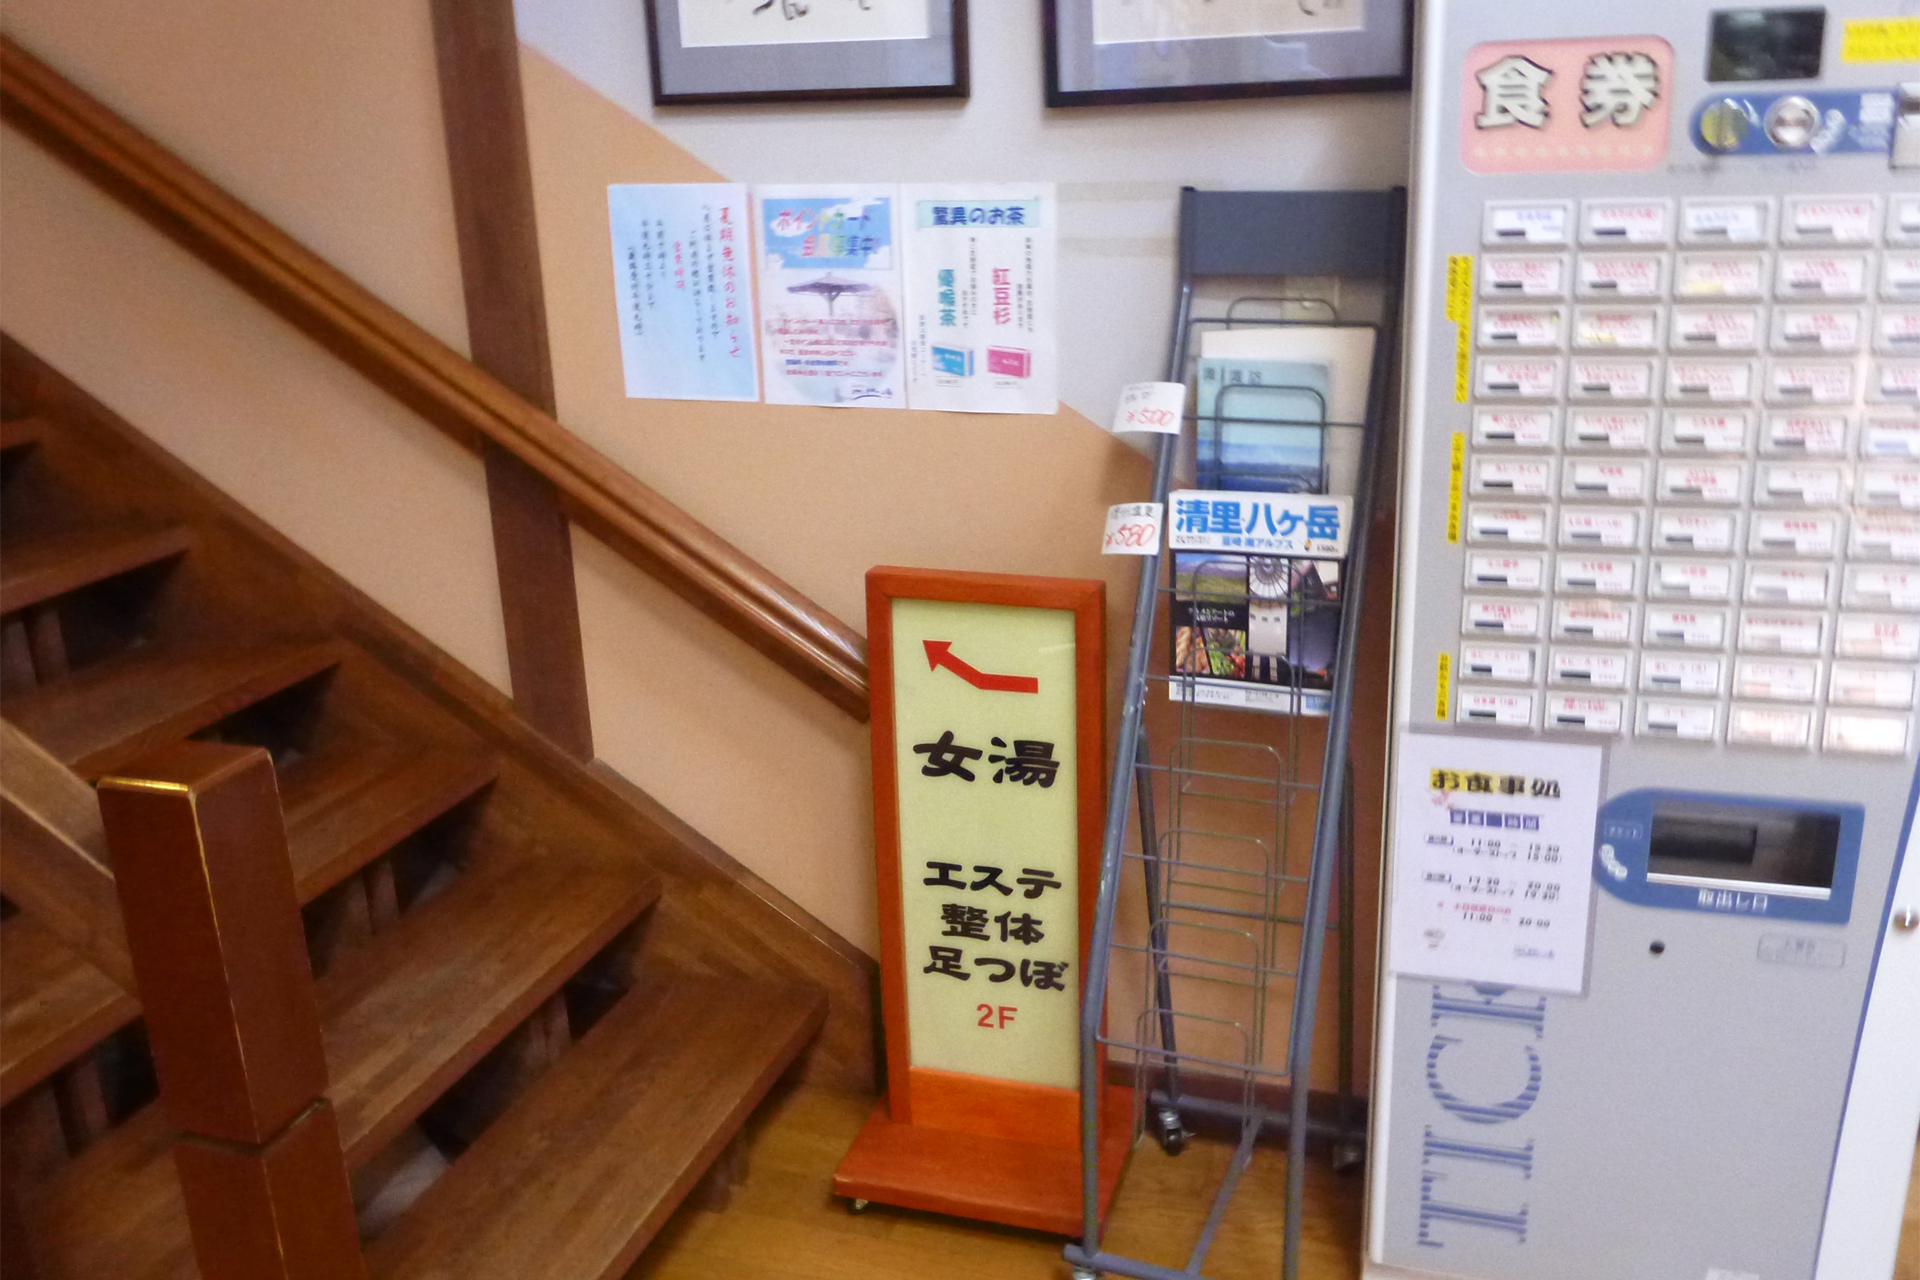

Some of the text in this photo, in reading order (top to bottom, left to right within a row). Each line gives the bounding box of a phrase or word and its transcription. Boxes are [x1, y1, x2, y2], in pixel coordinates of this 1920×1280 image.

[1474, 52, 1660, 130] 食券
[932, 206, 1025, 226] 驚異のお茶
[913, 731, 1060, 788] 女湯
[923, 861, 1062, 898] エステ
[941, 903, 1045, 945] 整体
[923, 945, 1069, 992] 足つぼ
[976, 1003, 1018, 1030] 2F
